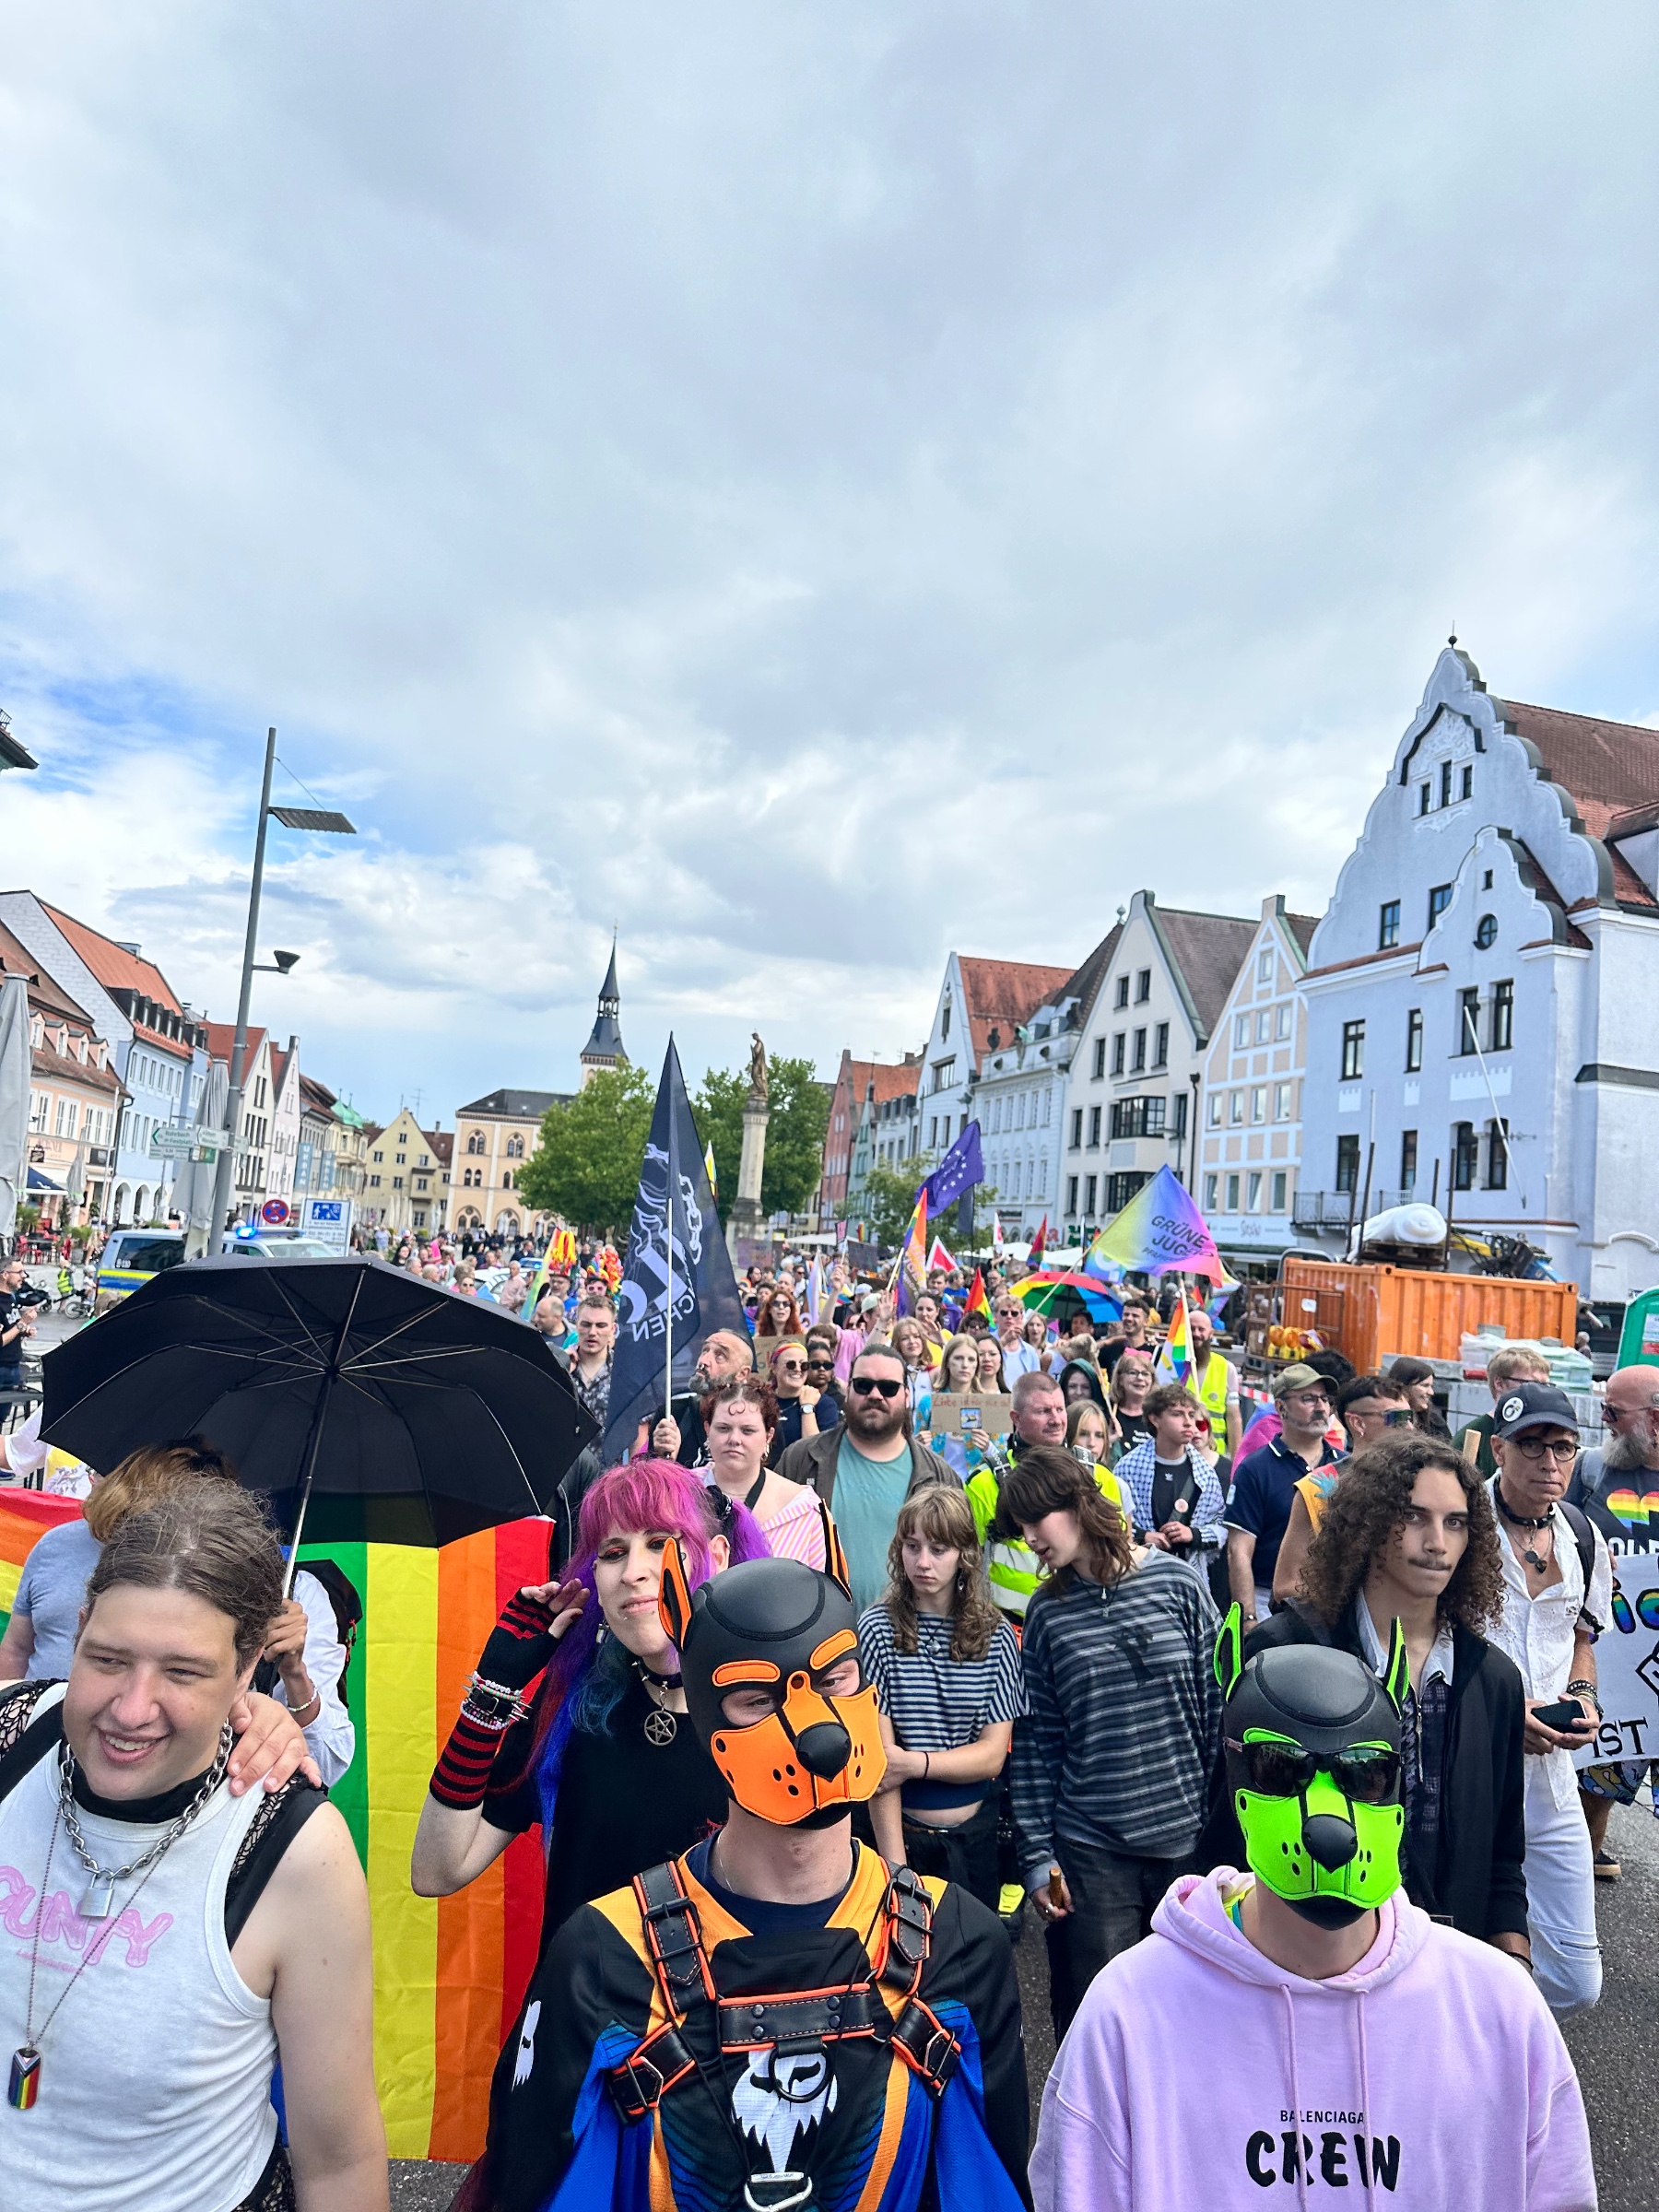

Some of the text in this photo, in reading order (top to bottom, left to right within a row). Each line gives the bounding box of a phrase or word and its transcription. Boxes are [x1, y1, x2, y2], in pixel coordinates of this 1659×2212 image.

[300, 1146, 310, 1185] URBAN
[323, 1153, 332, 1189] URBAN
[1151, 1214, 1210, 1249] GRÜNE
[1152, 1234, 1215, 1257] JUGD
[1280, 2110, 1365, 2124] BALENCIAGA
[1246, 2130, 1400, 2192] CREW
